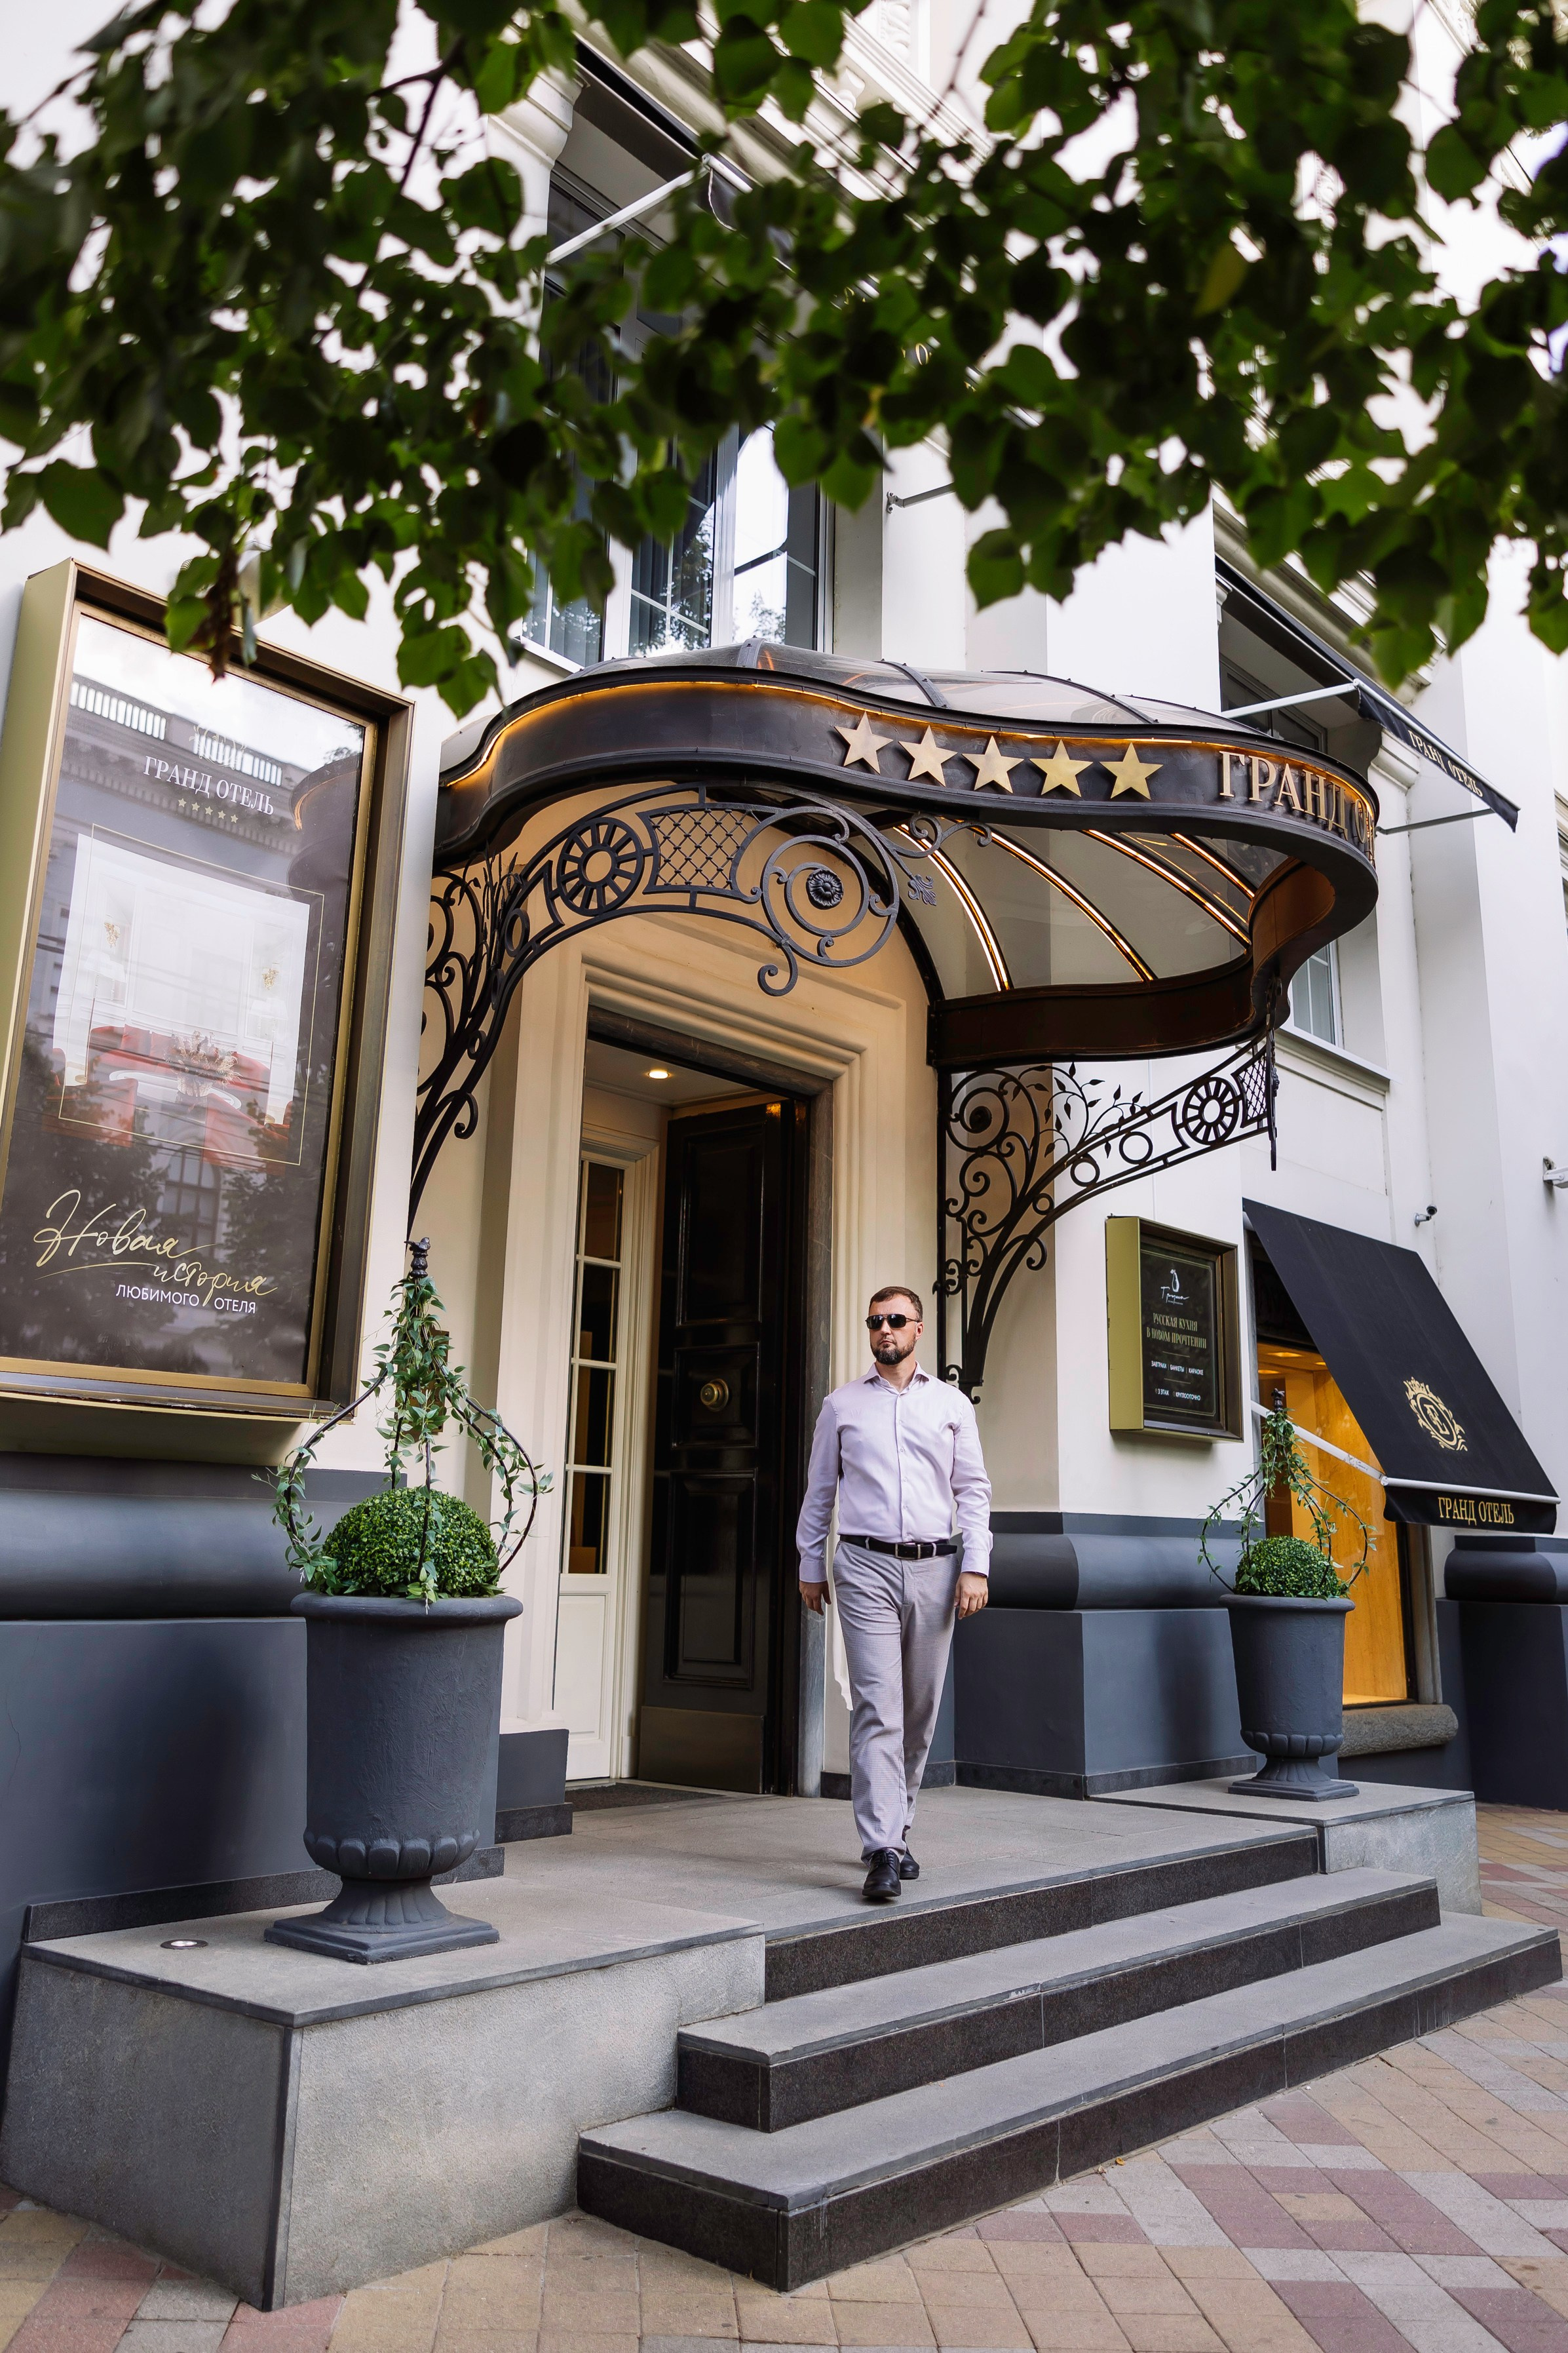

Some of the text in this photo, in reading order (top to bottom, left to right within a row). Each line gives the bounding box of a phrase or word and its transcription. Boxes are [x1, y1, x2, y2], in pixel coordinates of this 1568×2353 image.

[1407, 729, 1483, 797] ГРАНД ОТЕЛЬ
[143, 756, 275, 815] ГРАНД ОТЕЛЬ
[1219, 750, 1348, 841] ГРАНД
[33, 1189, 218, 1267] Новая
[115, 1284, 257, 1314] ЛЮБИМОГО ОТЕЛЯ
[153, 1262, 278, 1306] история
[1147, 1327, 1206, 1349] В НОВОМ ПРОЧТЕНИИ
[1153, 1312, 1198, 1332] РУССКАЯ КУХНЯ
[1151, 1360, 1204, 1376] ЗАВТРАКИ БАНКЕТЫ КАРАОКЕ
[1438, 1496, 1514, 1526] ГРАНД ОТЕЛЬ
